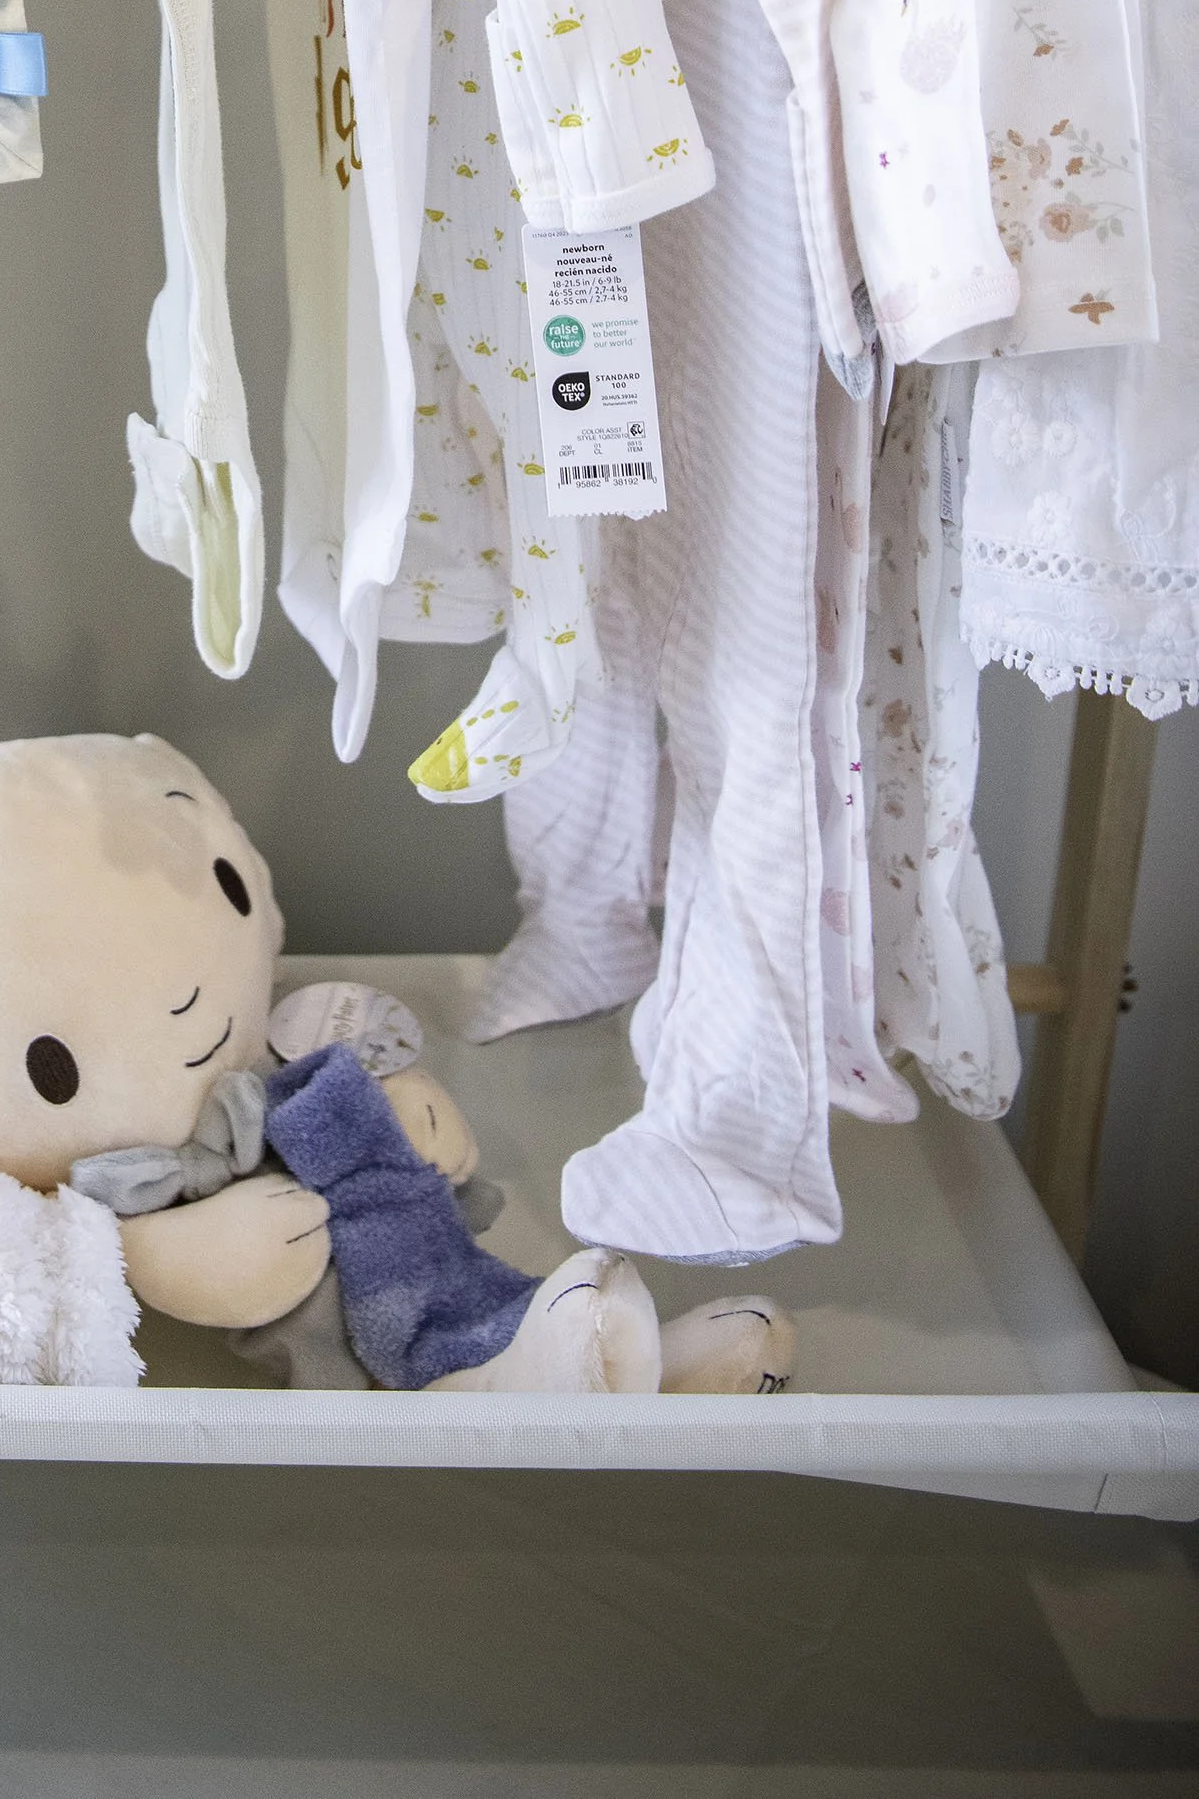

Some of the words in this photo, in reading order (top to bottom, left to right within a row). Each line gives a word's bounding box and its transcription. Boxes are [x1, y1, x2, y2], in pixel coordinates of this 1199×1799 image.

[562, 244, 605, 254] newborn
[557, 254, 613, 266] nouveau-né
[555, 267, 583, 277] recién
[586, 265, 617, 274] nacido
[553, 279, 581, 289] 18-21.5
[582, 278, 590, 286] in
[598, 277, 612, 285] 6-9
[614, 275, 622, 283] lb
[549, 288, 573, 297] 46-55
[617, 285, 628, 294] kg
[550, 298, 574, 307] 46-55
[618, 293, 629, 302] kg
[549, 323, 579, 335] raise
[606, 319, 639, 329] promise
[603, 329, 627, 337] better
[551, 339, 580, 349] future
[595, 372, 640, 382] STANDARD
[558, 382, 585, 393] OEKO
[575, 479, 601, 489] 95862
[613, 477, 639, 487] 38192
